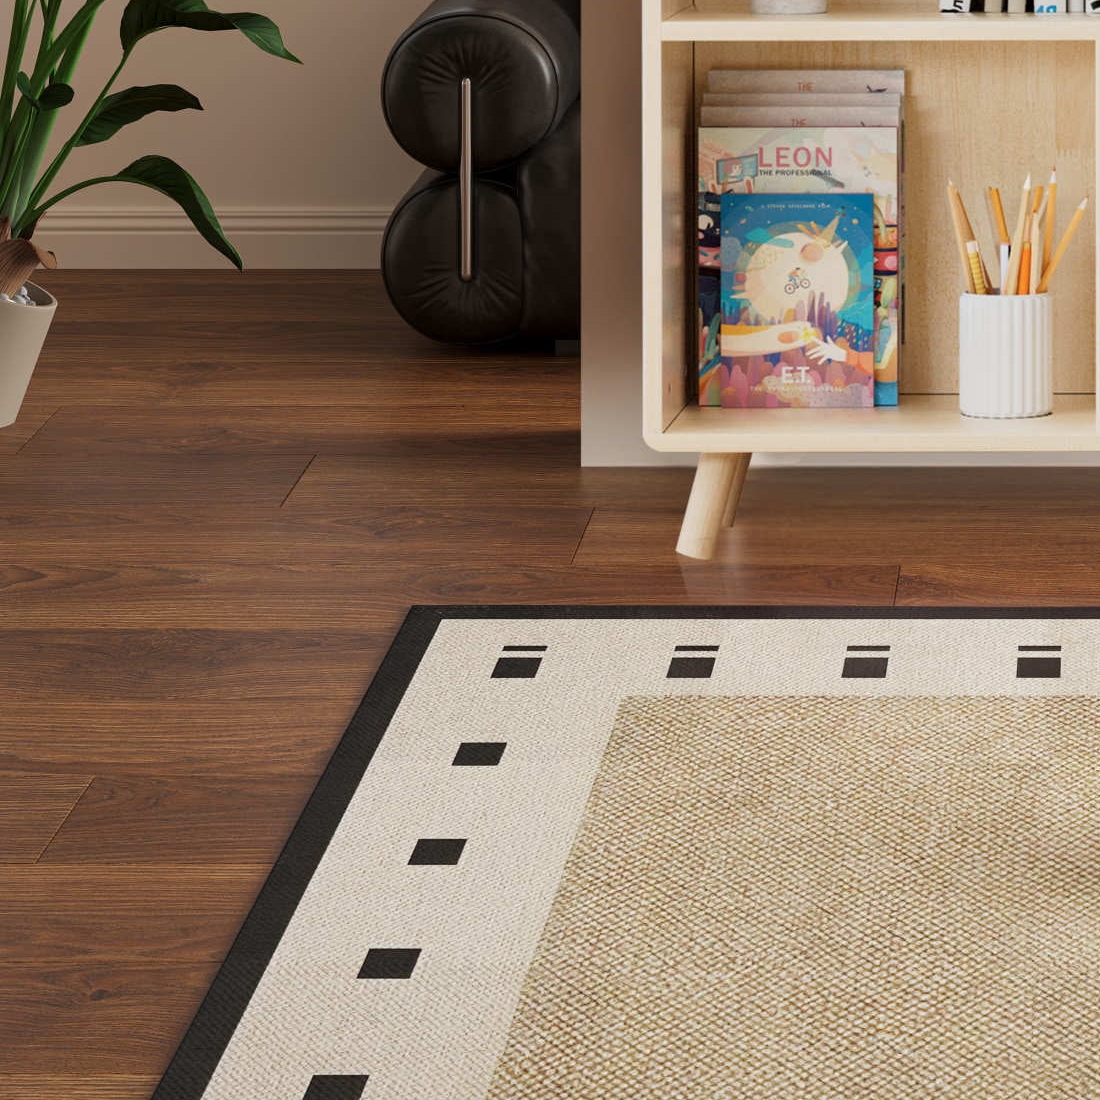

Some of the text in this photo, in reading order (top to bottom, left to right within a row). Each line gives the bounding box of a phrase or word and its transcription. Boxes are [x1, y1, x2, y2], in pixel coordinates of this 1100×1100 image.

[796, 82, 814, 92] THE
[791, 118, 807, 127] THE
[758, 146, 833, 168] LEON
